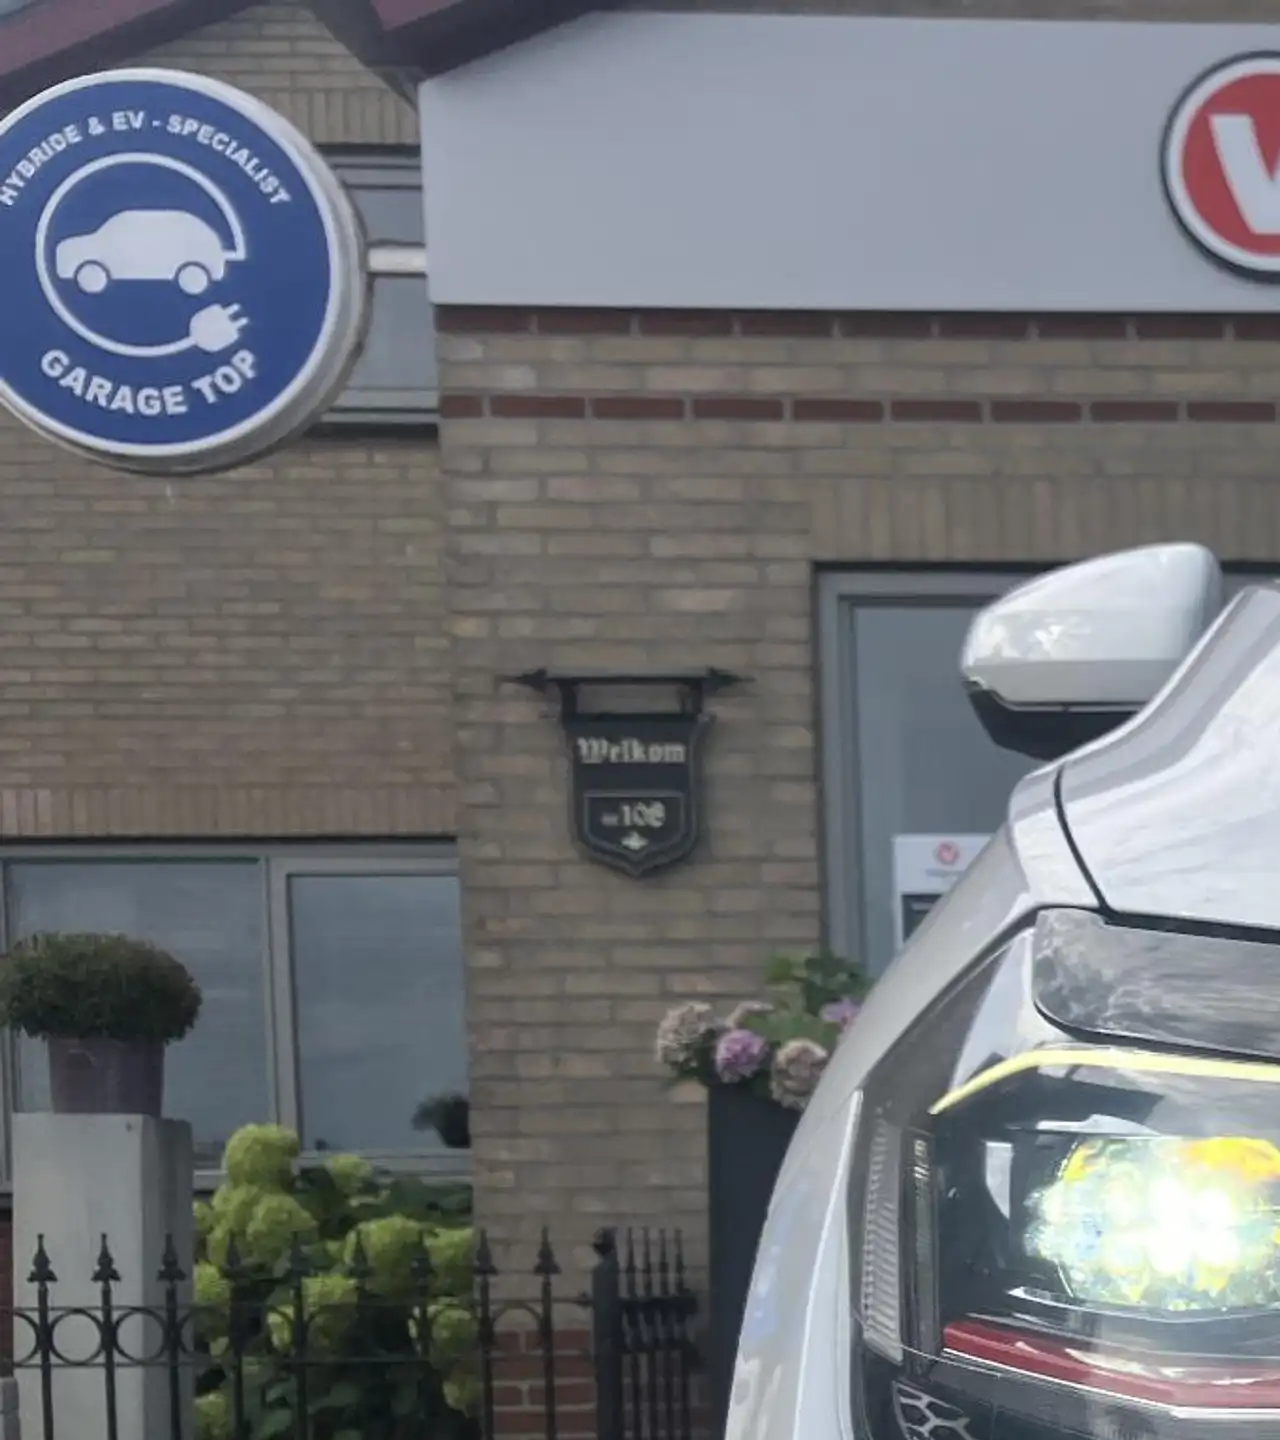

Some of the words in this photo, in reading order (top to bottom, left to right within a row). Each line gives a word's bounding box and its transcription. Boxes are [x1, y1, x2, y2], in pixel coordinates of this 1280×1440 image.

[0, 123, 83, 206] HYBRIDE
[87, 116, 105, 135] &
[111, 110, 144, 131] EV
[166, 114, 291, 204] SPECIALIST
[40, 349, 188, 416] GARAGE
[190, 349, 257, 404] TOP
